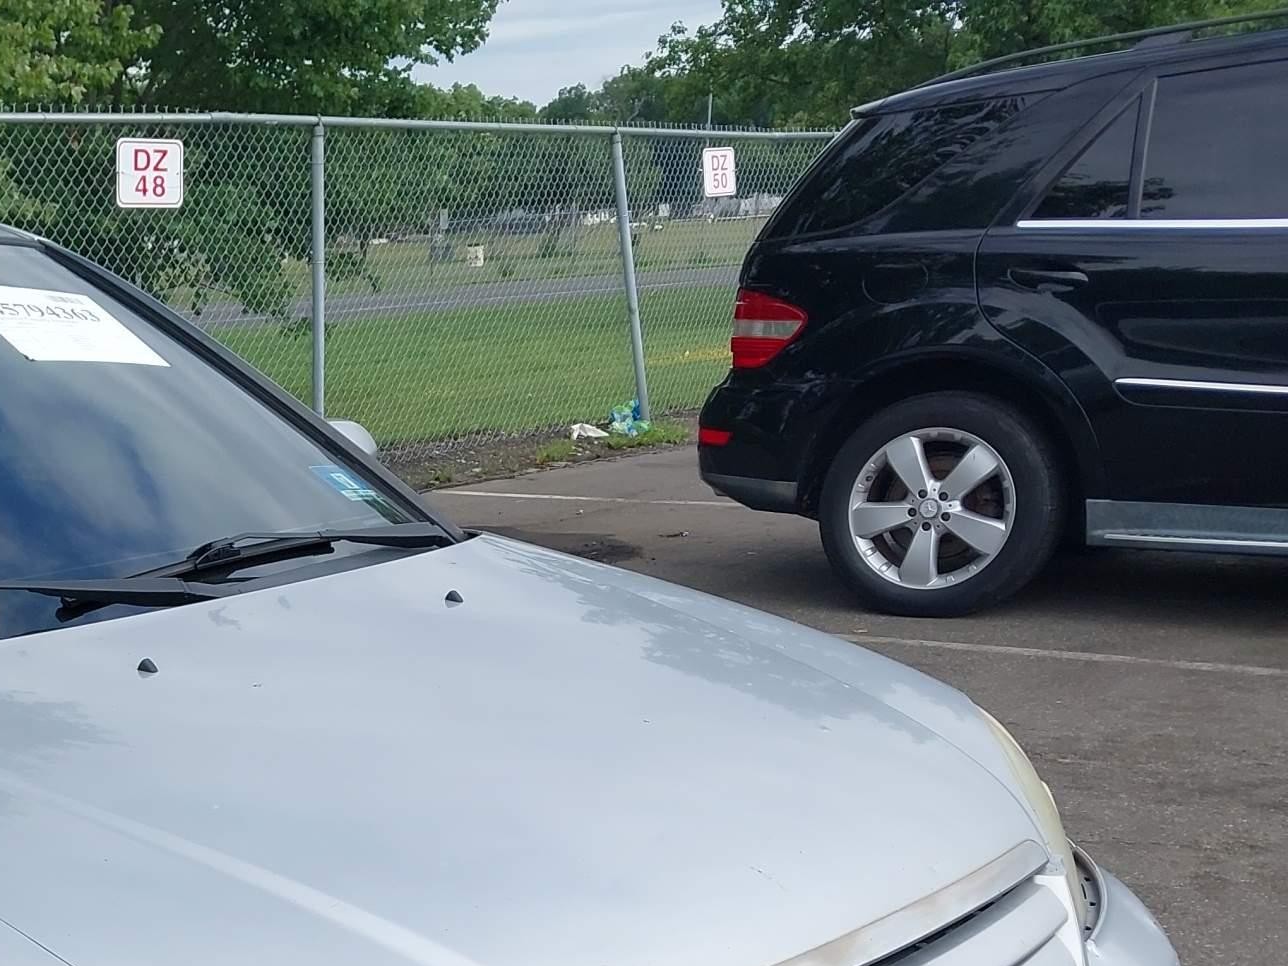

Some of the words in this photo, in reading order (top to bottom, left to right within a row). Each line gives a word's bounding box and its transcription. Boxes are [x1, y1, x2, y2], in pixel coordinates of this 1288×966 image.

[134, 149, 168, 172] DZ
[712, 155, 728, 171] DZ
[135, 175, 165, 197] 48
[713, 173, 727, 188] 50
